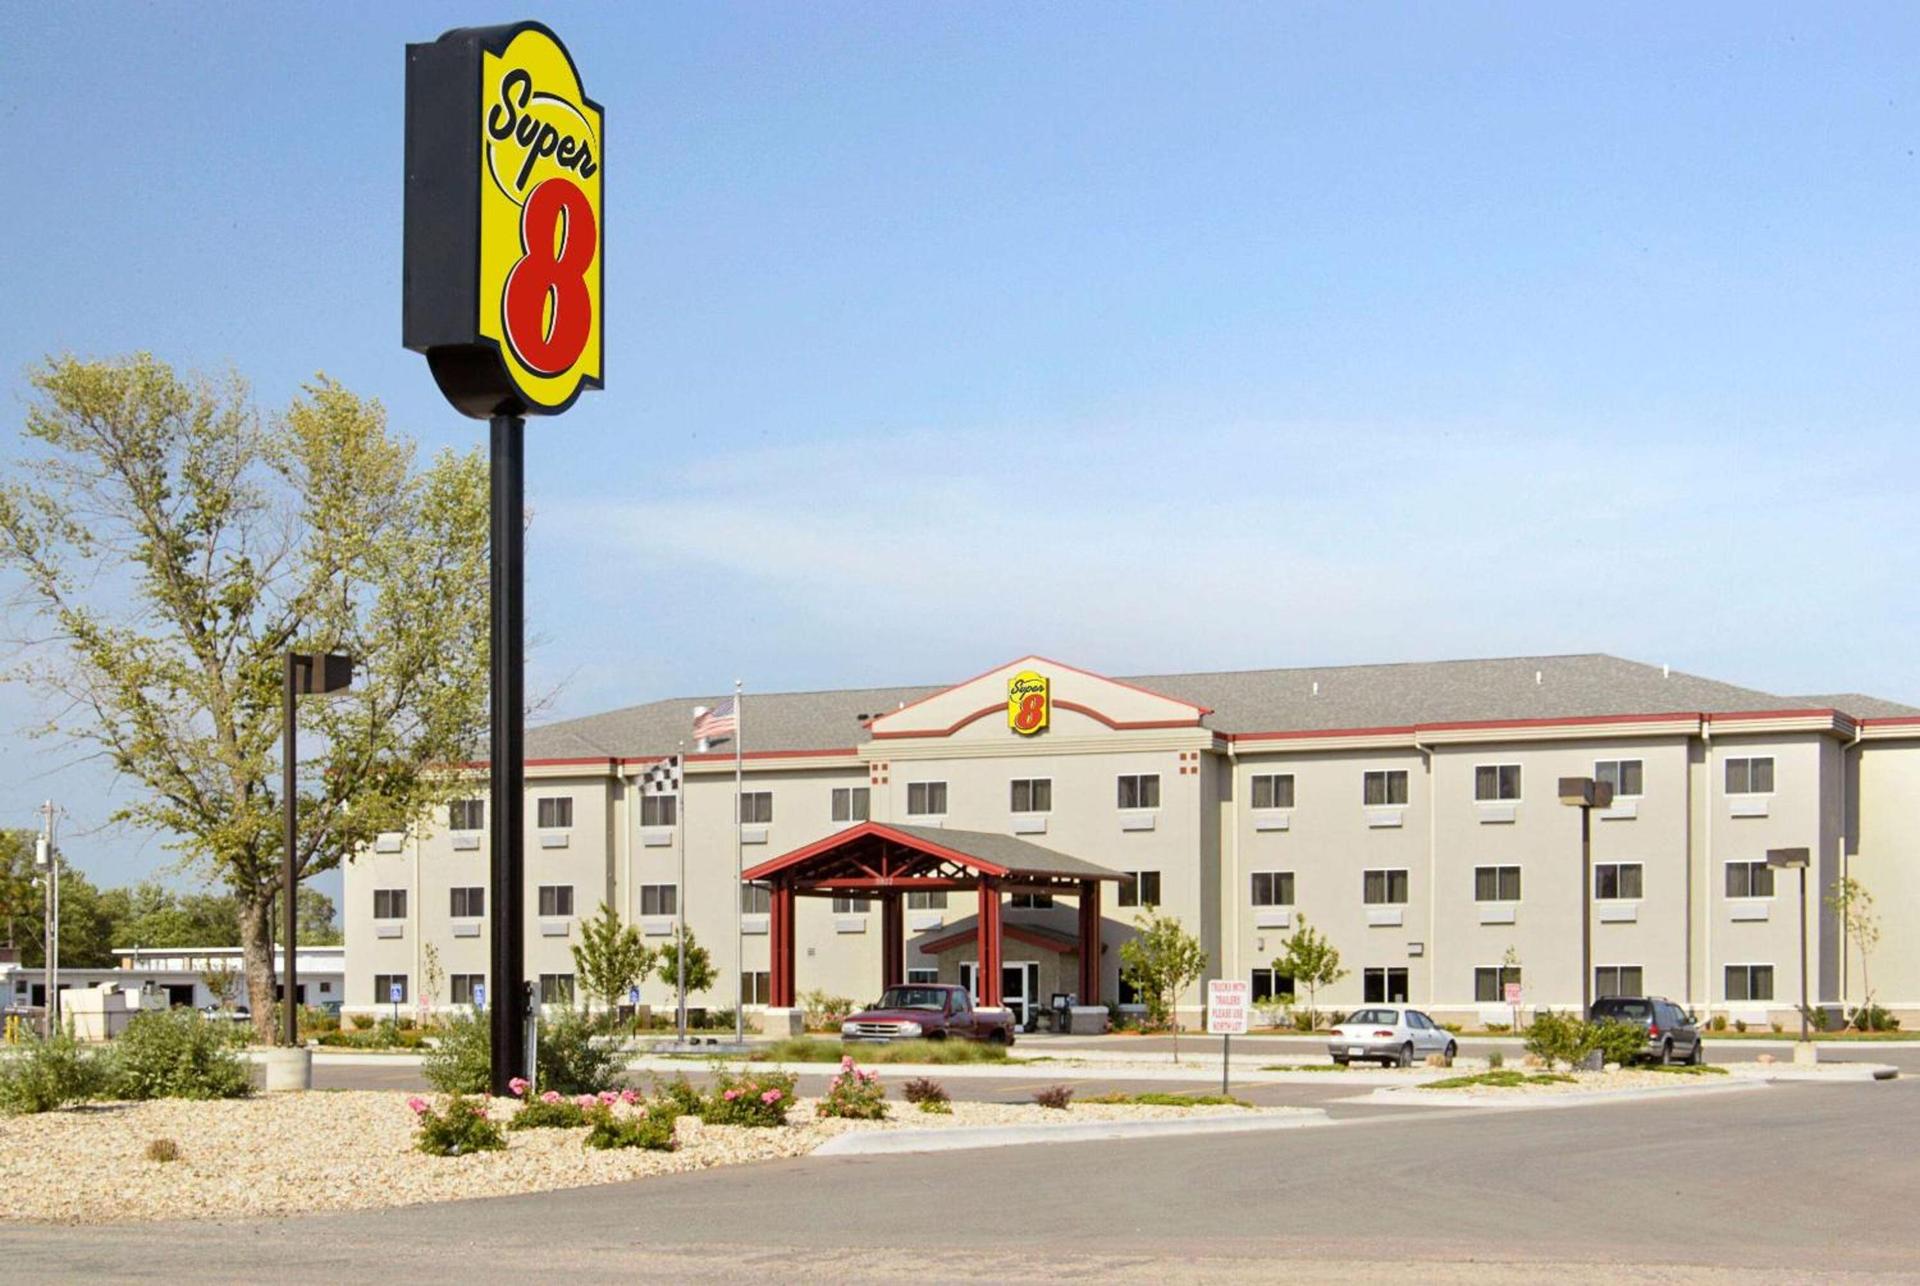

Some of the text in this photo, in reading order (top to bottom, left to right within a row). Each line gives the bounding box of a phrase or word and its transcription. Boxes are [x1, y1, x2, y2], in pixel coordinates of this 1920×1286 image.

[488, 68, 598, 192] Super
[502, 177, 597, 378] 8
[1010, 678, 1045, 701] Super
[1014, 693, 1045, 730] 8
[1210, 982, 1246, 992] TRUCKS WITH
[1215, 995, 1241, 1005] TRAILERS
[1211, 1008, 1243, 1019] PLEASE USE
